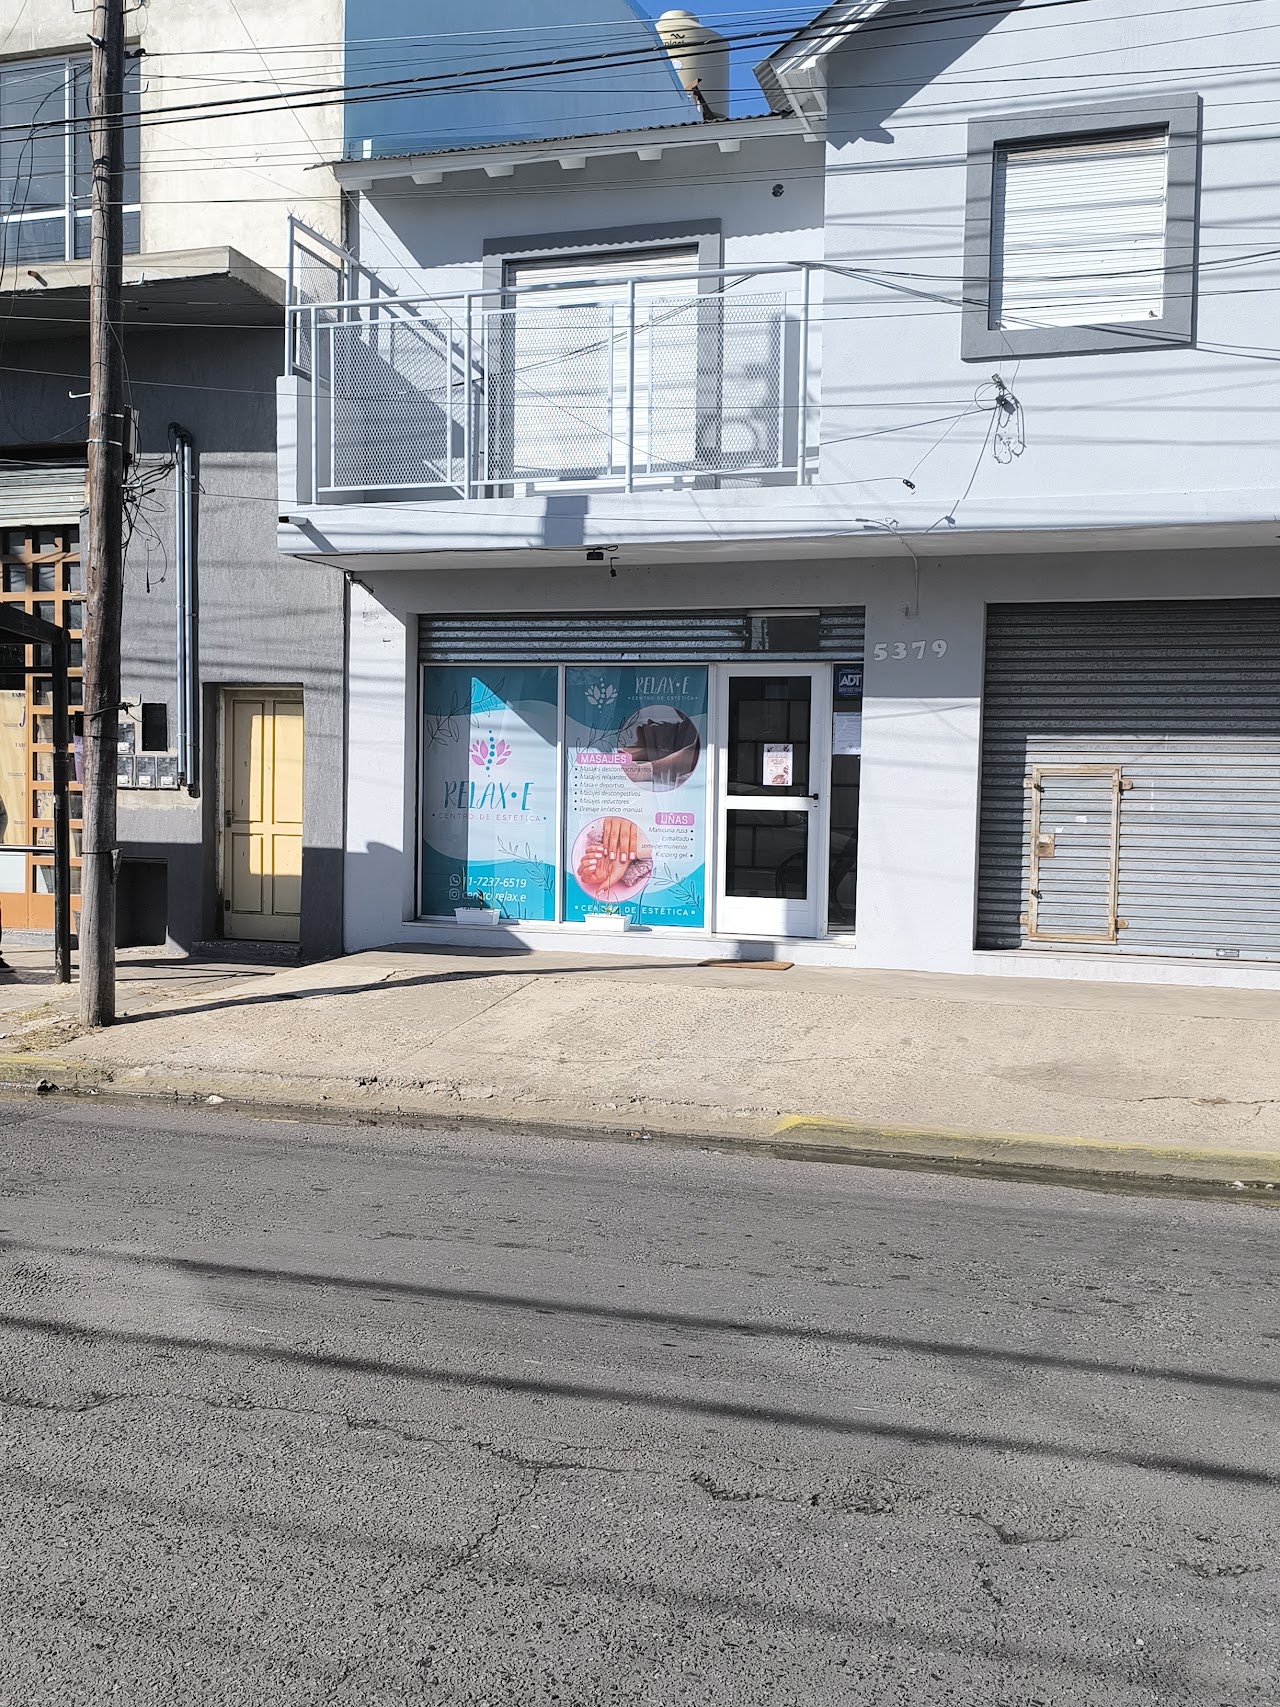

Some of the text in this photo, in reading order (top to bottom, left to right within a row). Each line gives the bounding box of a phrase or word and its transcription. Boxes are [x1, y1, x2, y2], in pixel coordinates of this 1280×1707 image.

[873, 639, 948, 661] 5379
[839, 674, 862, 686] ADT
[580, 754, 627, 764] MASAJES
[579, 765, 601, 774] Masajes
[579, 773, 601, 781] Masajes
[579, 798, 601, 806] Masajes
[579, 805, 600, 814] Drenaje
[660, 813, 688, 825] UÑAS
[661, 834, 689, 842] Esmaltado
[655, 851, 678, 860] Kapping
[624, 906, 636, 914] DE
[641, 906, 689, 916] ESTÉTICA
